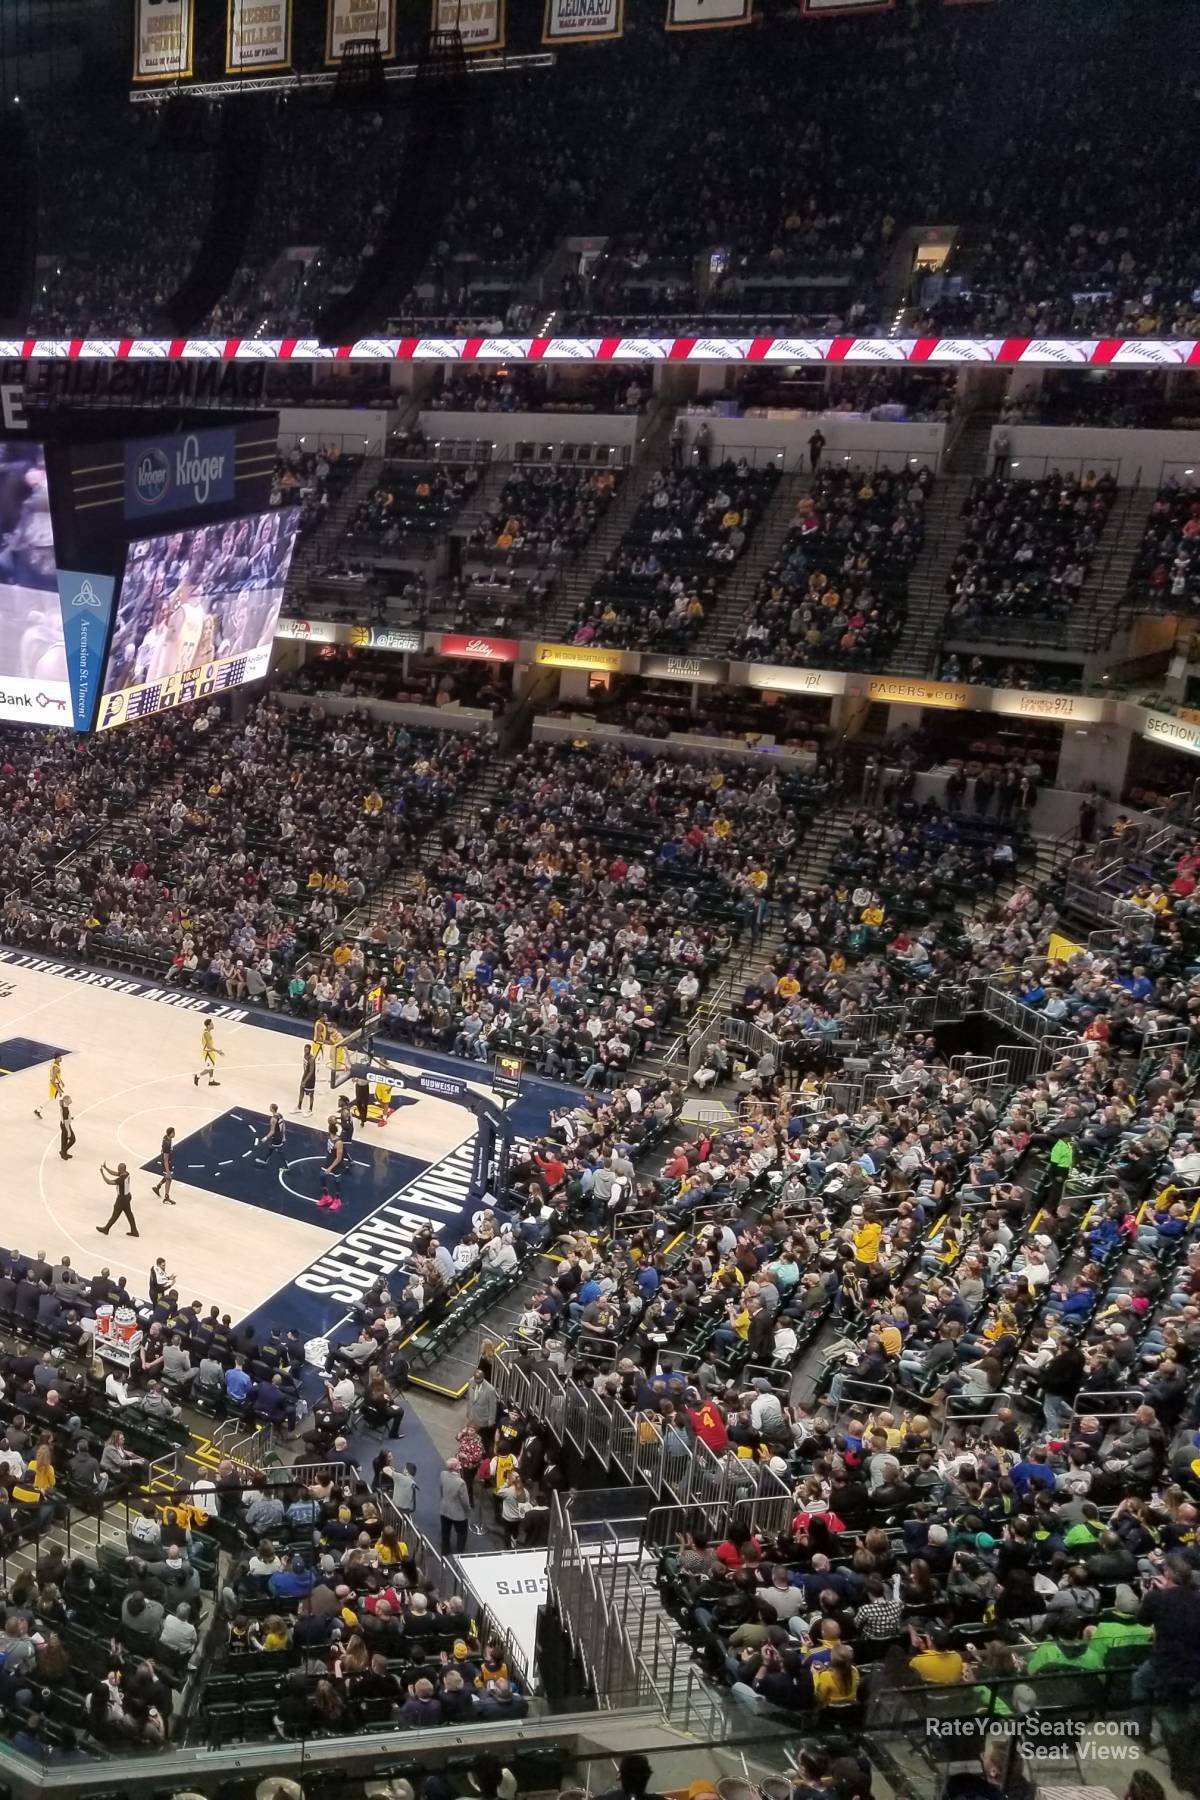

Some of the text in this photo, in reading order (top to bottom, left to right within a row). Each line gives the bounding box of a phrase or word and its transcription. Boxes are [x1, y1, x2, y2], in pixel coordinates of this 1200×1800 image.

[137, 457, 167, 487] Kroger
[175, 434, 225, 504] Kroger
[81, 619, 90, 668] Ascension
[376, 634, 419, 650] @Pacers
[466, 638, 494, 657] Lilly
[182, 668, 201, 684] 10:48
[804, 673, 822, 688] ipl
[1054, 698, 1074, 712] 97.1
[1148, 718, 1195, 743] SECTION
[15, 951, 141, 995] BASKETBALL
[141, 988, 211, 1012] GROW
[208, 1006, 249, 1021] WE
[366, 1072, 405, 1088] GEICO
[420, 1078, 460, 1094] BUDWEISER
[703, 1412, 716, 1429] 4
